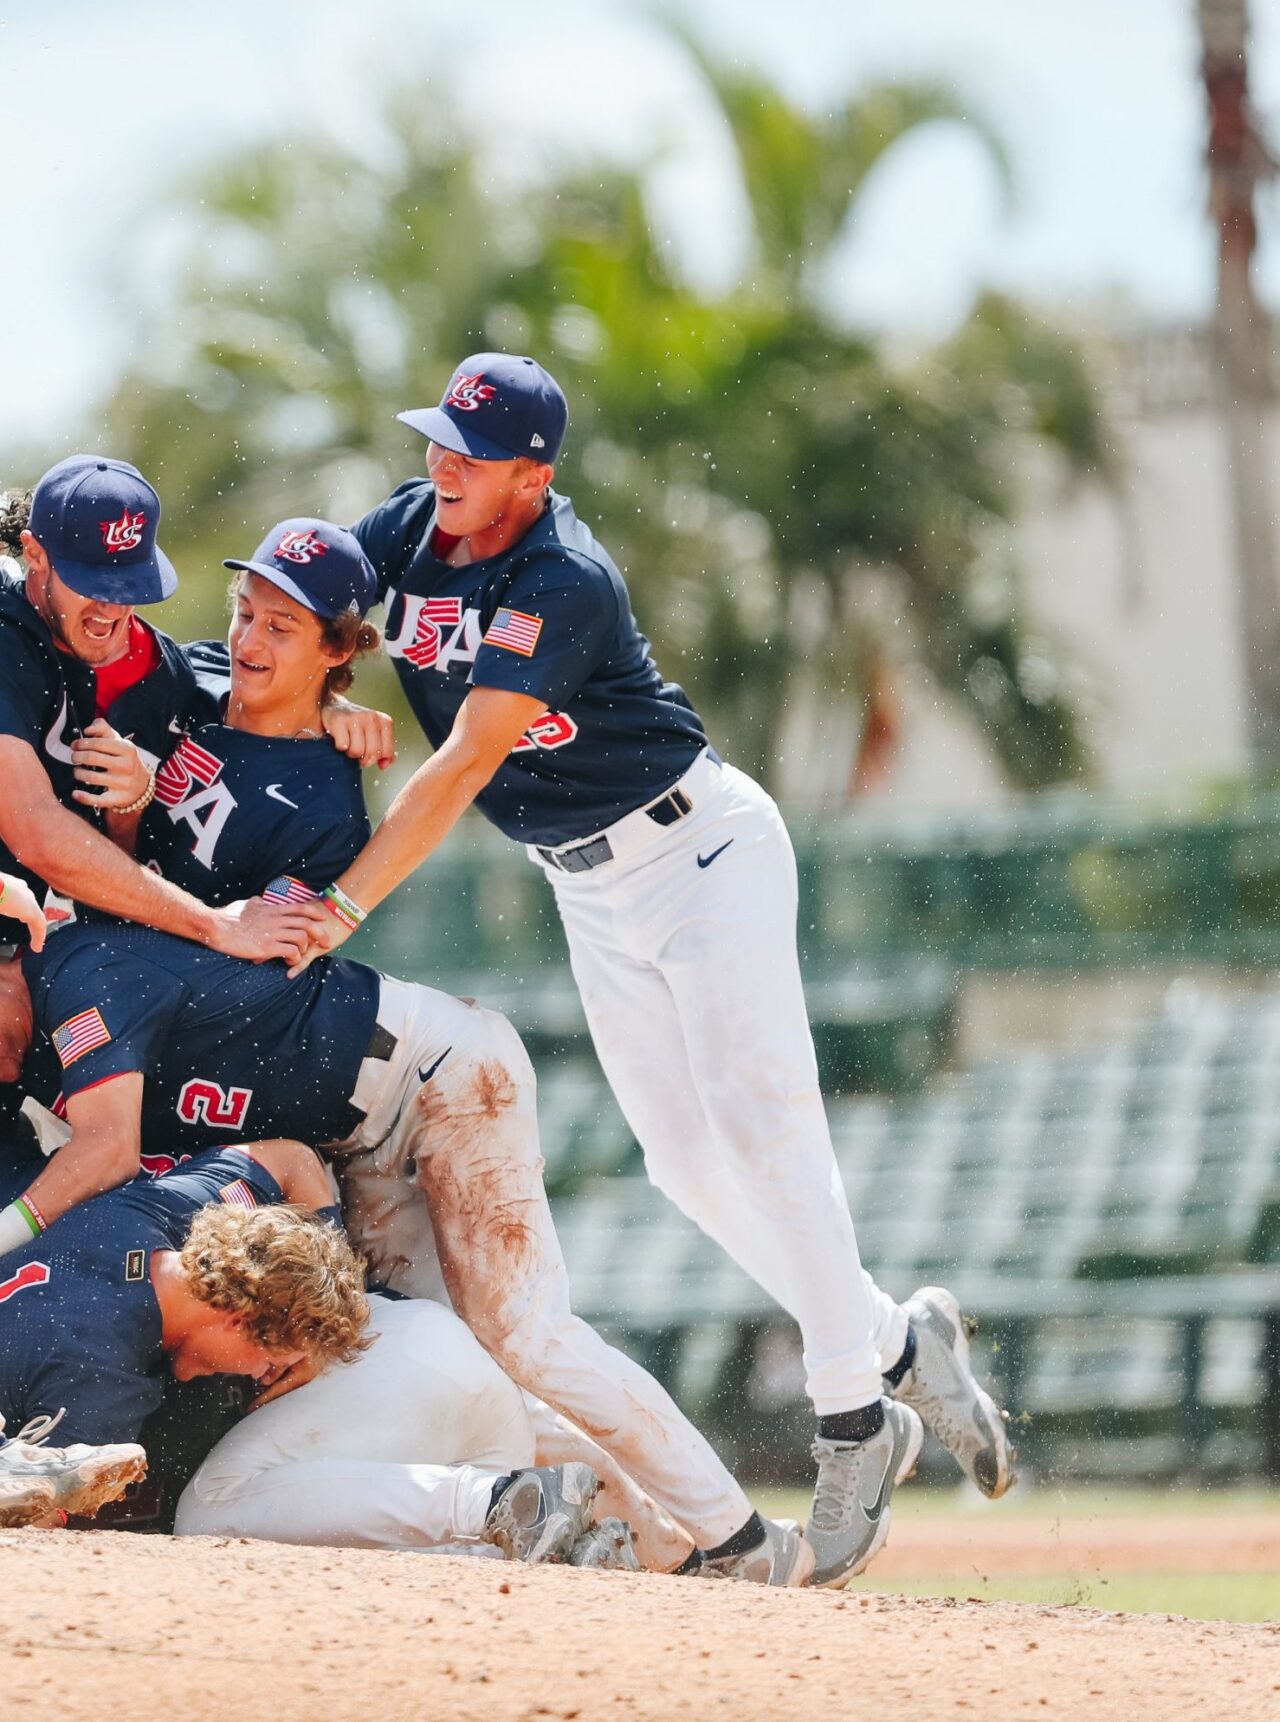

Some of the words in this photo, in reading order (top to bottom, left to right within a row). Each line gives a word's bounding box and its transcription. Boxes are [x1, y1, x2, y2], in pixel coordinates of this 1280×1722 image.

[104, 509, 146, 552] US
[383, 587, 482, 675] USA
[176, 1078, 253, 1130] 2
